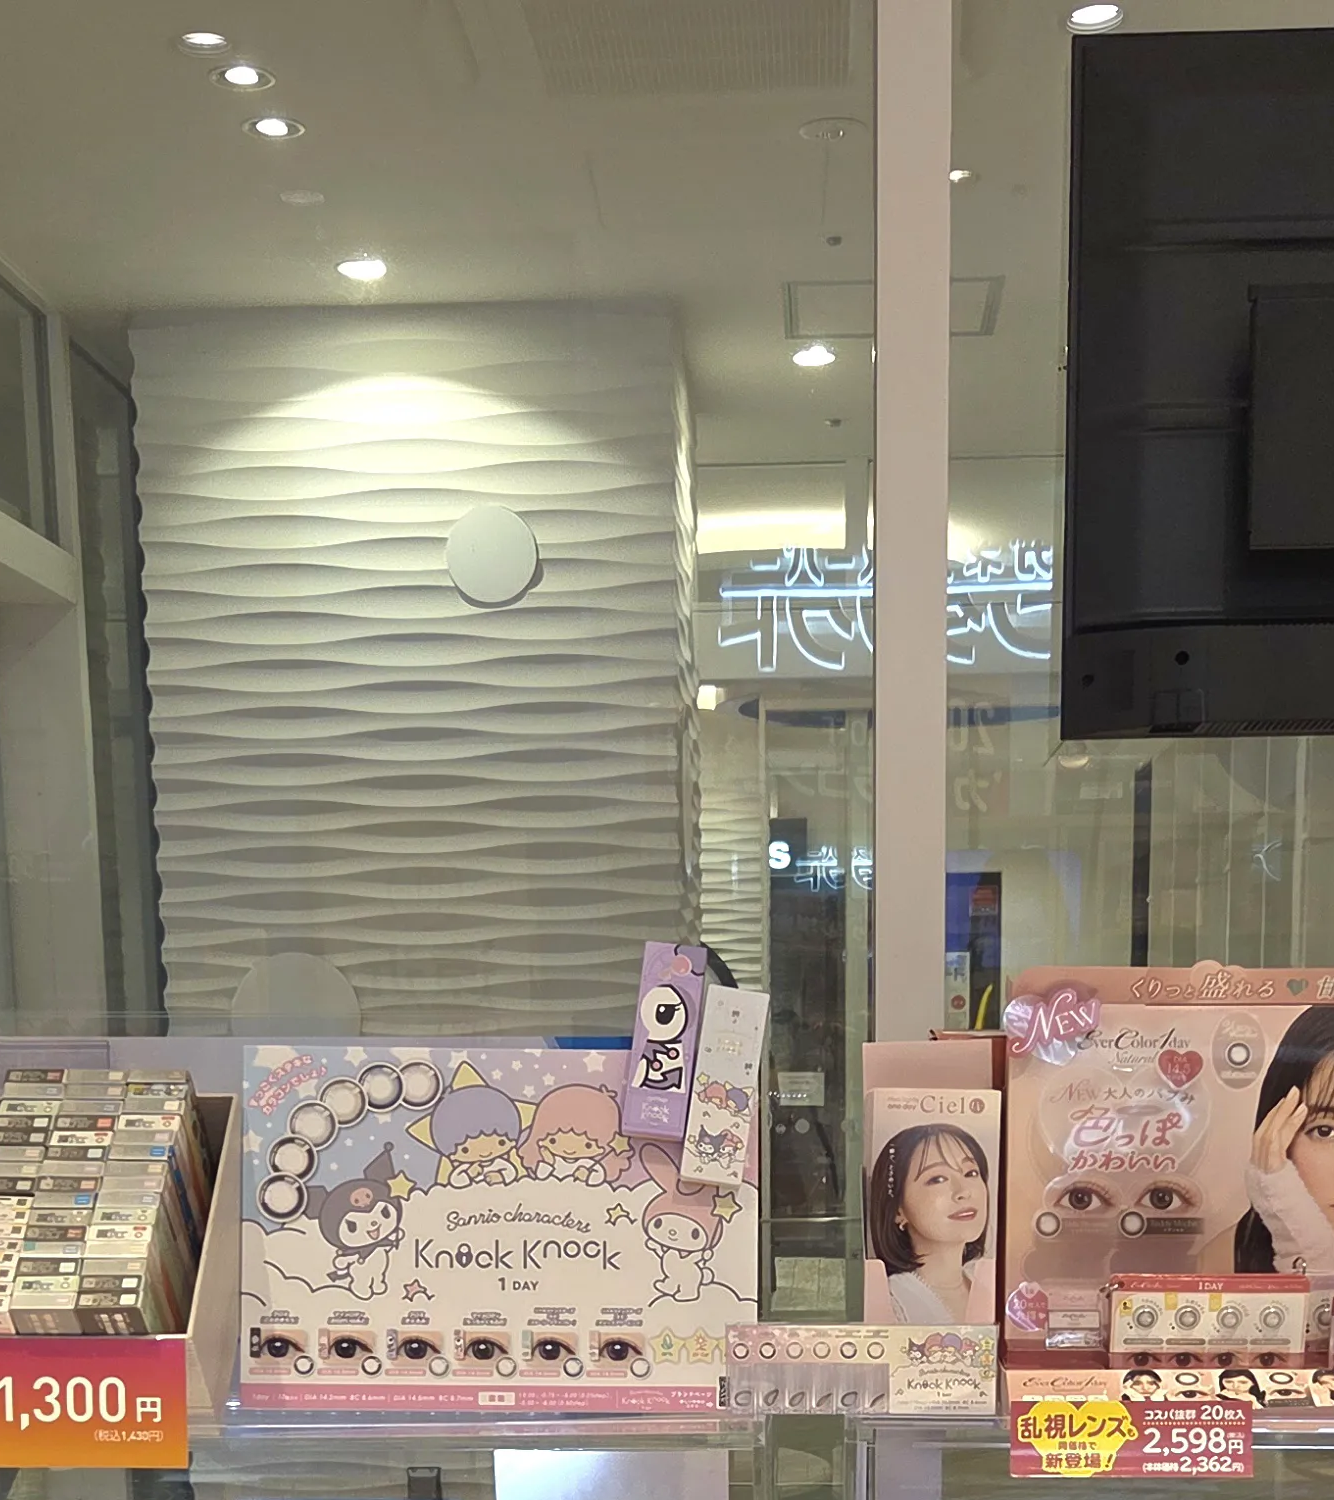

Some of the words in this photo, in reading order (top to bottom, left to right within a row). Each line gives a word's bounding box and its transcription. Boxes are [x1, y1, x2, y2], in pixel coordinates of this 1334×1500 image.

[1129, 972, 1275, 999] くりっと盛れる
[1012, 992, 1097, 1054] NEW
[1111, 1051, 1157, 1065] Natural
[920, 1095, 965, 1114] Ciel
[1070, 1151, 1176, 1171] かわいい
[446, 1210, 502, 1233] Sanrio
[503, 1203, 592, 1233] characters
[414, 1238, 514, 1270] Knock
[522, 1238, 622, 1270] Knock
[512, 1280, 539, 1291] DAY
[1144, 1409, 1196, 1420] コスパ抜群
[1200, 1405, 1245, 1420] 20枚入
[93, 1429, 164, 1443] (税込1,430円)
[1020, 1414, 1136, 1439] 乱視レンズも
[1045, 1453, 1113, 1469] 新登場!
